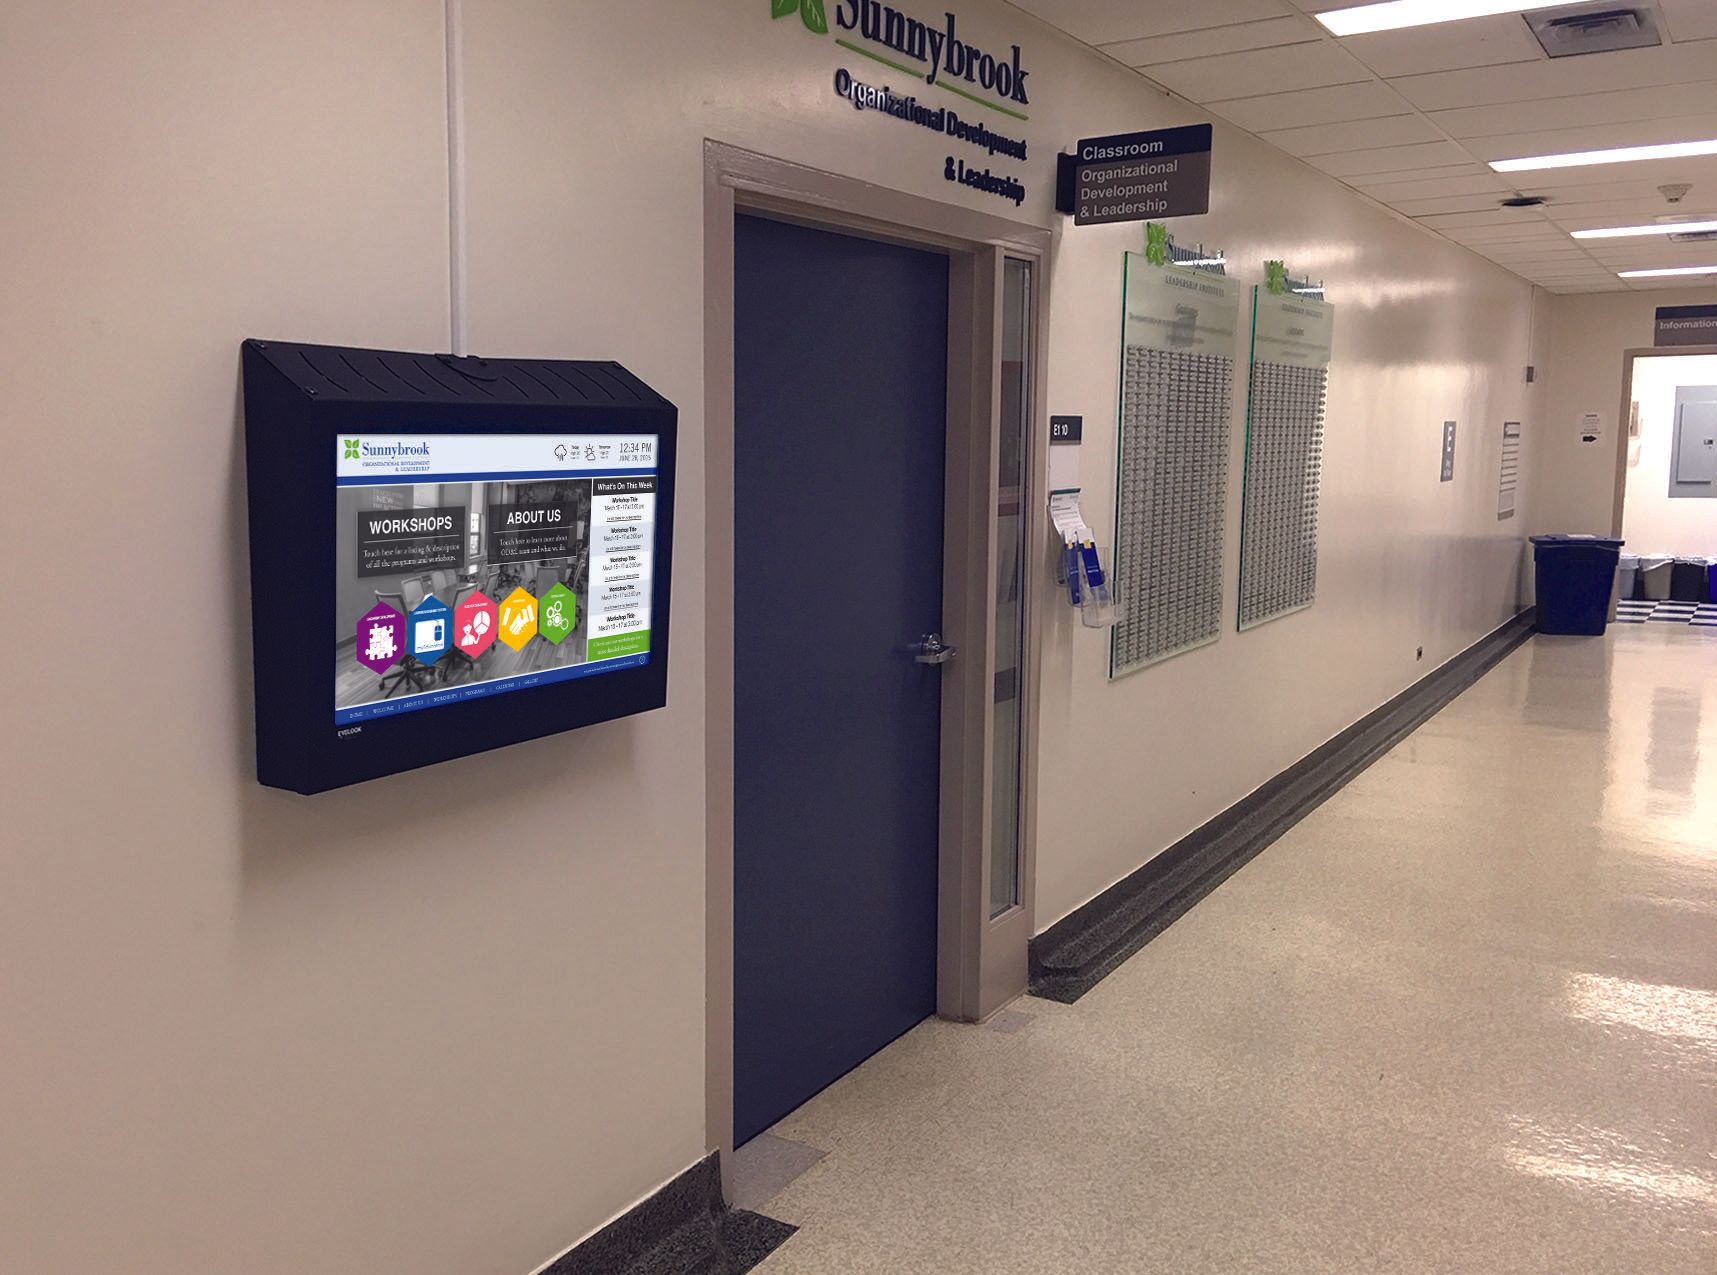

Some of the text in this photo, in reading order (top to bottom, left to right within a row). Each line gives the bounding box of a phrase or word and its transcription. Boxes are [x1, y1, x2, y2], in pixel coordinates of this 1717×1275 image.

[836, 0, 1030, 104] Sunnybrook
[835, 68, 1027, 161] Organizational Development
[1082, 141, 1163, 161] Classroom
[1081, 159, 1178, 183] Organizational
[944, 156, 1026, 207] & Leadership
[1081, 180, 1168, 200] Development
[1080, 198, 1168, 218] & Leadership
[362, 441, 430, 459] Sunnybrook
[620, 442, 652, 454] 12:34 PM
[597, 482, 616, 490] What's
[369, 516, 453, 534] WORKSHOPS
[507, 509, 561, 524] ABOUT US
